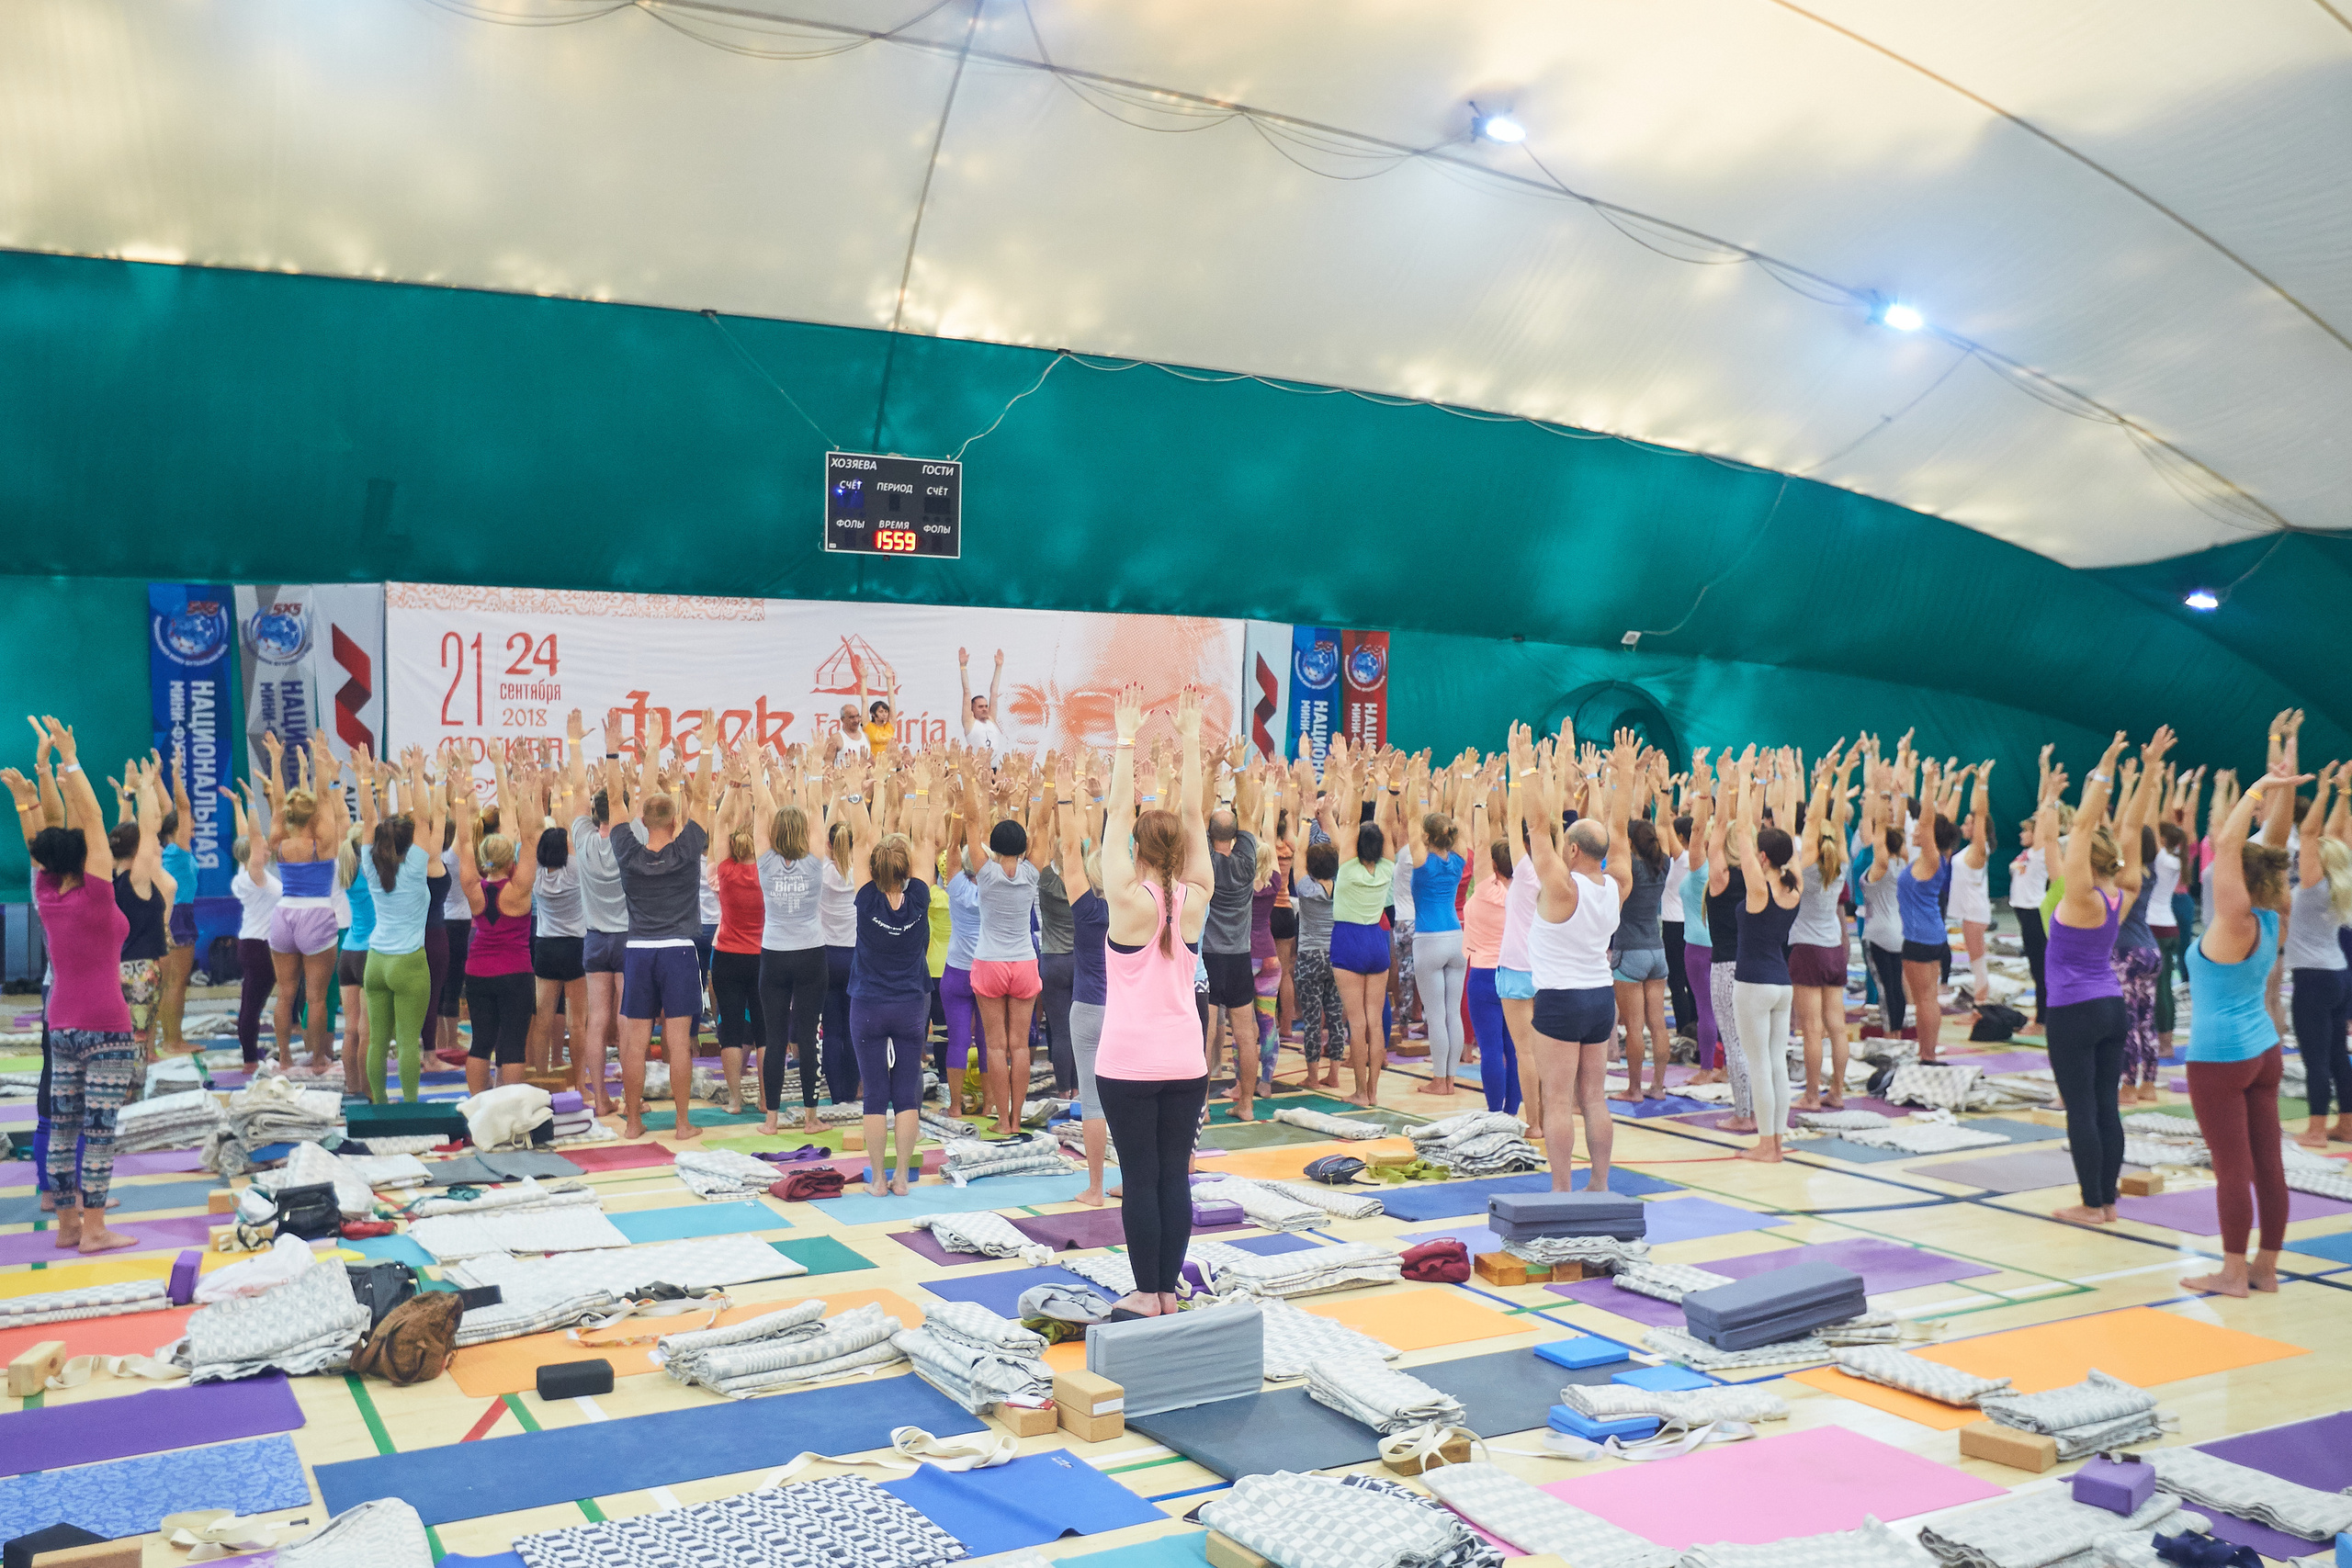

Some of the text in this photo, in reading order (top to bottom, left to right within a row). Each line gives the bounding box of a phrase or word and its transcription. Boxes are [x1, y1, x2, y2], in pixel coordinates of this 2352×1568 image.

[831, 457, 955, 476] ХОЗЯЕВА ГОСТИ
[840, 479, 948, 496] СЧЁТ ПЕРИОД СЧЁТ
[836, 519, 951, 535] ФОЛЫ ВРЕМЯ ФОЛЫ
[876, 531, 917, 551] 1559
[505, 632, 560, 677] 24
[441, 631, 483, 727] 21
[500, 679, 561, 705] сентября
[503, 707, 548, 727] 2018
[1300, 700, 1311, 731] МИНИ
[188, 681, 220, 869] НАЦИОНАЛЬНАЯ
